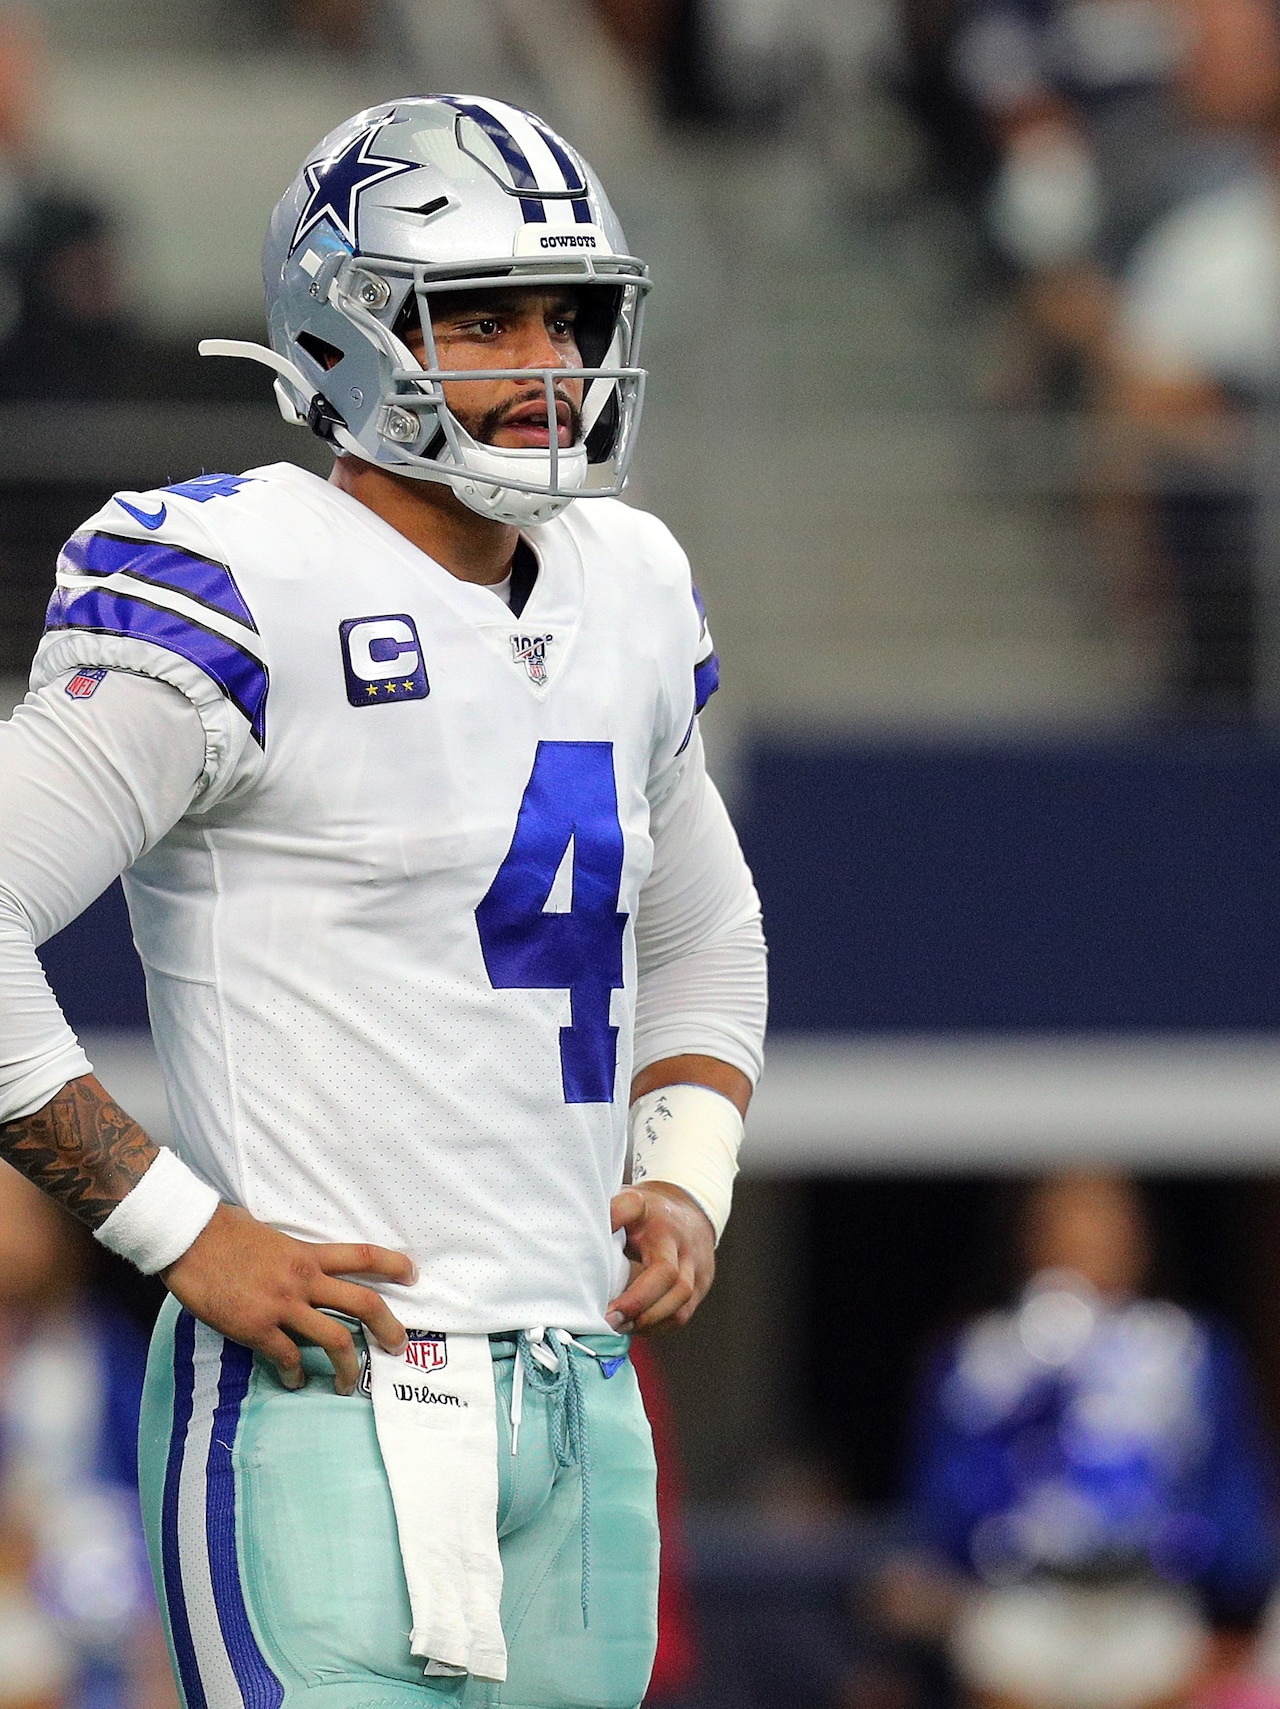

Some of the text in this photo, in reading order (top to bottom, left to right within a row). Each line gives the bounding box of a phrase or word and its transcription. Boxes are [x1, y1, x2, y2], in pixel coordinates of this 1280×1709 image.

[540, 235, 596, 248] COWBOYS
[349, 620, 419, 681] C
[69, 675, 95, 696] NFL
[475, 740, 630, 1103] 4
[405, 1342, 443, 1369] NFL
